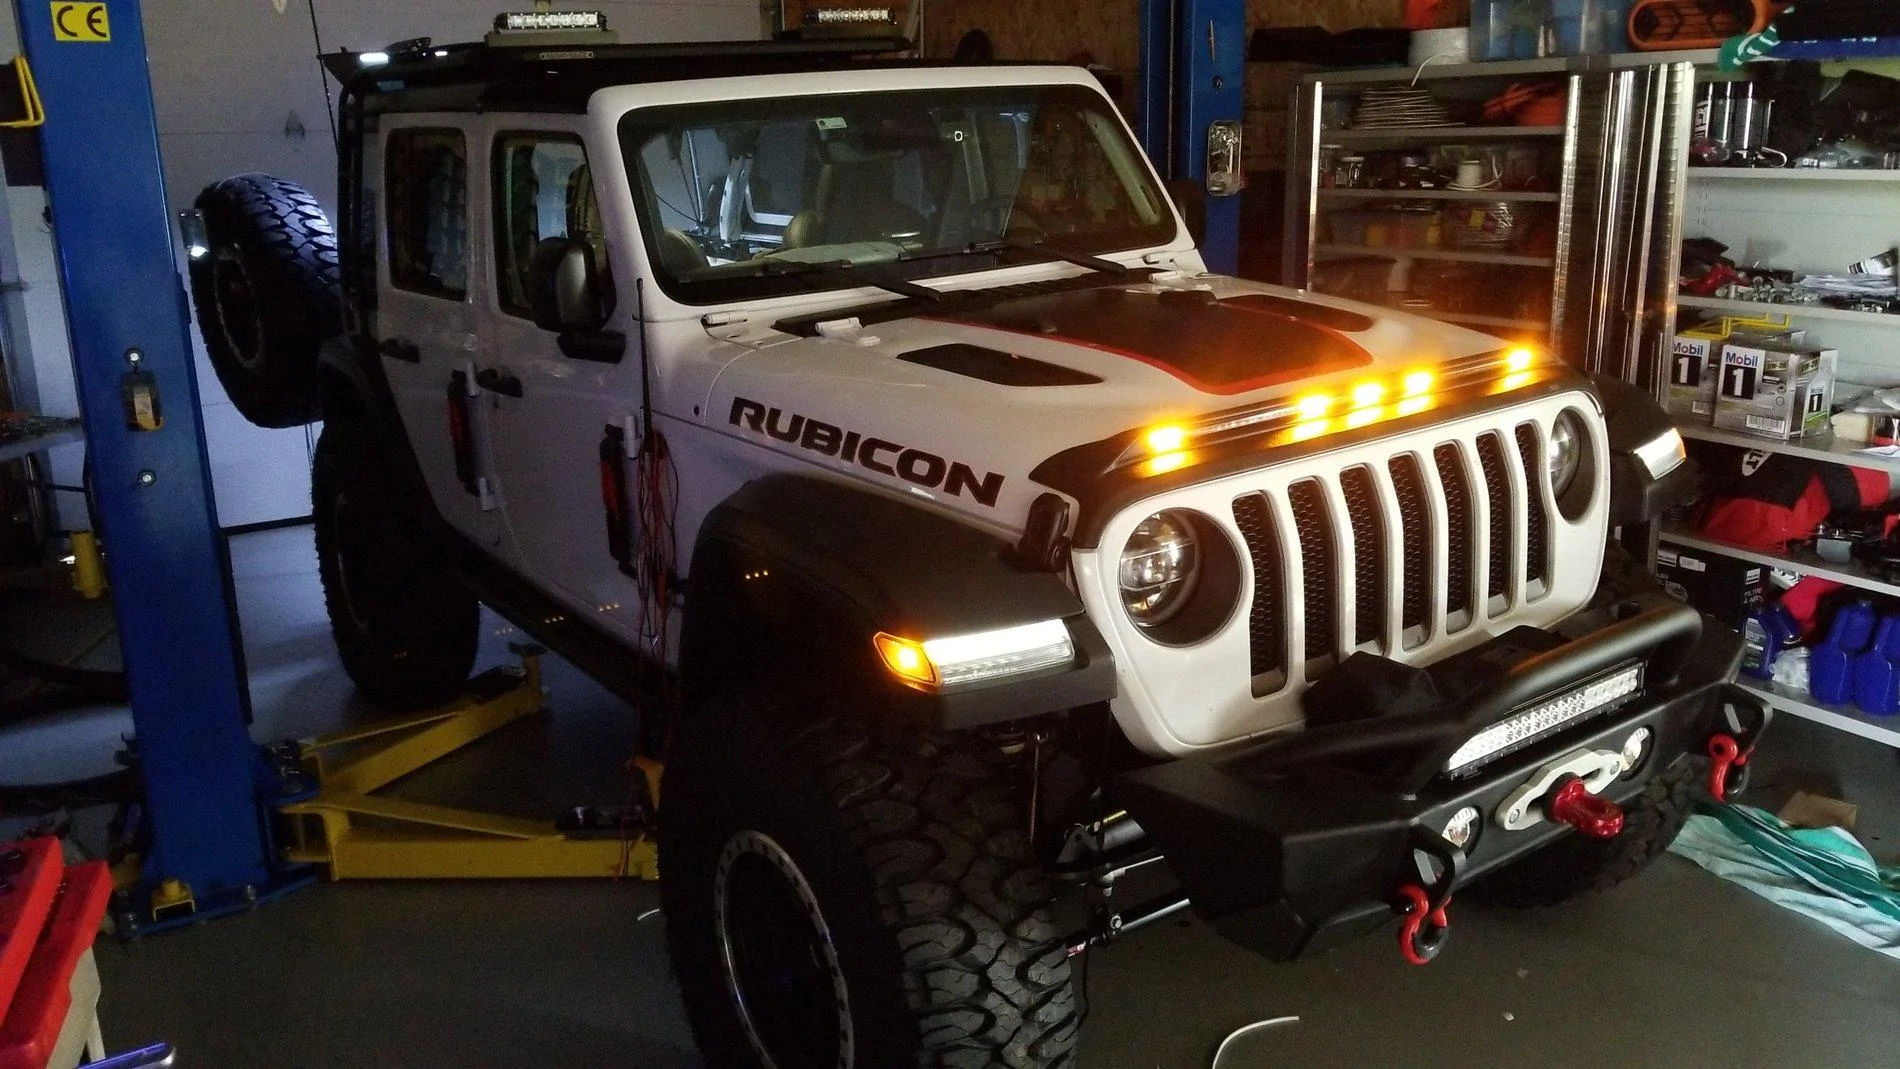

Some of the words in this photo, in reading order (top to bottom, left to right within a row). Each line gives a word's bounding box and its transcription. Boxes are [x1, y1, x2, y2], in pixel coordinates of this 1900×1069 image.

[56, 5, 107, 38] CE
[1678, 357, 1690, 384] 1
[1725, 351, 1758, 367] Mobil
[1732, 368, 1745, 397] 1
[1813, 395, 1819, 412] 1
[729, 396, 1006, 508] RUBICON
